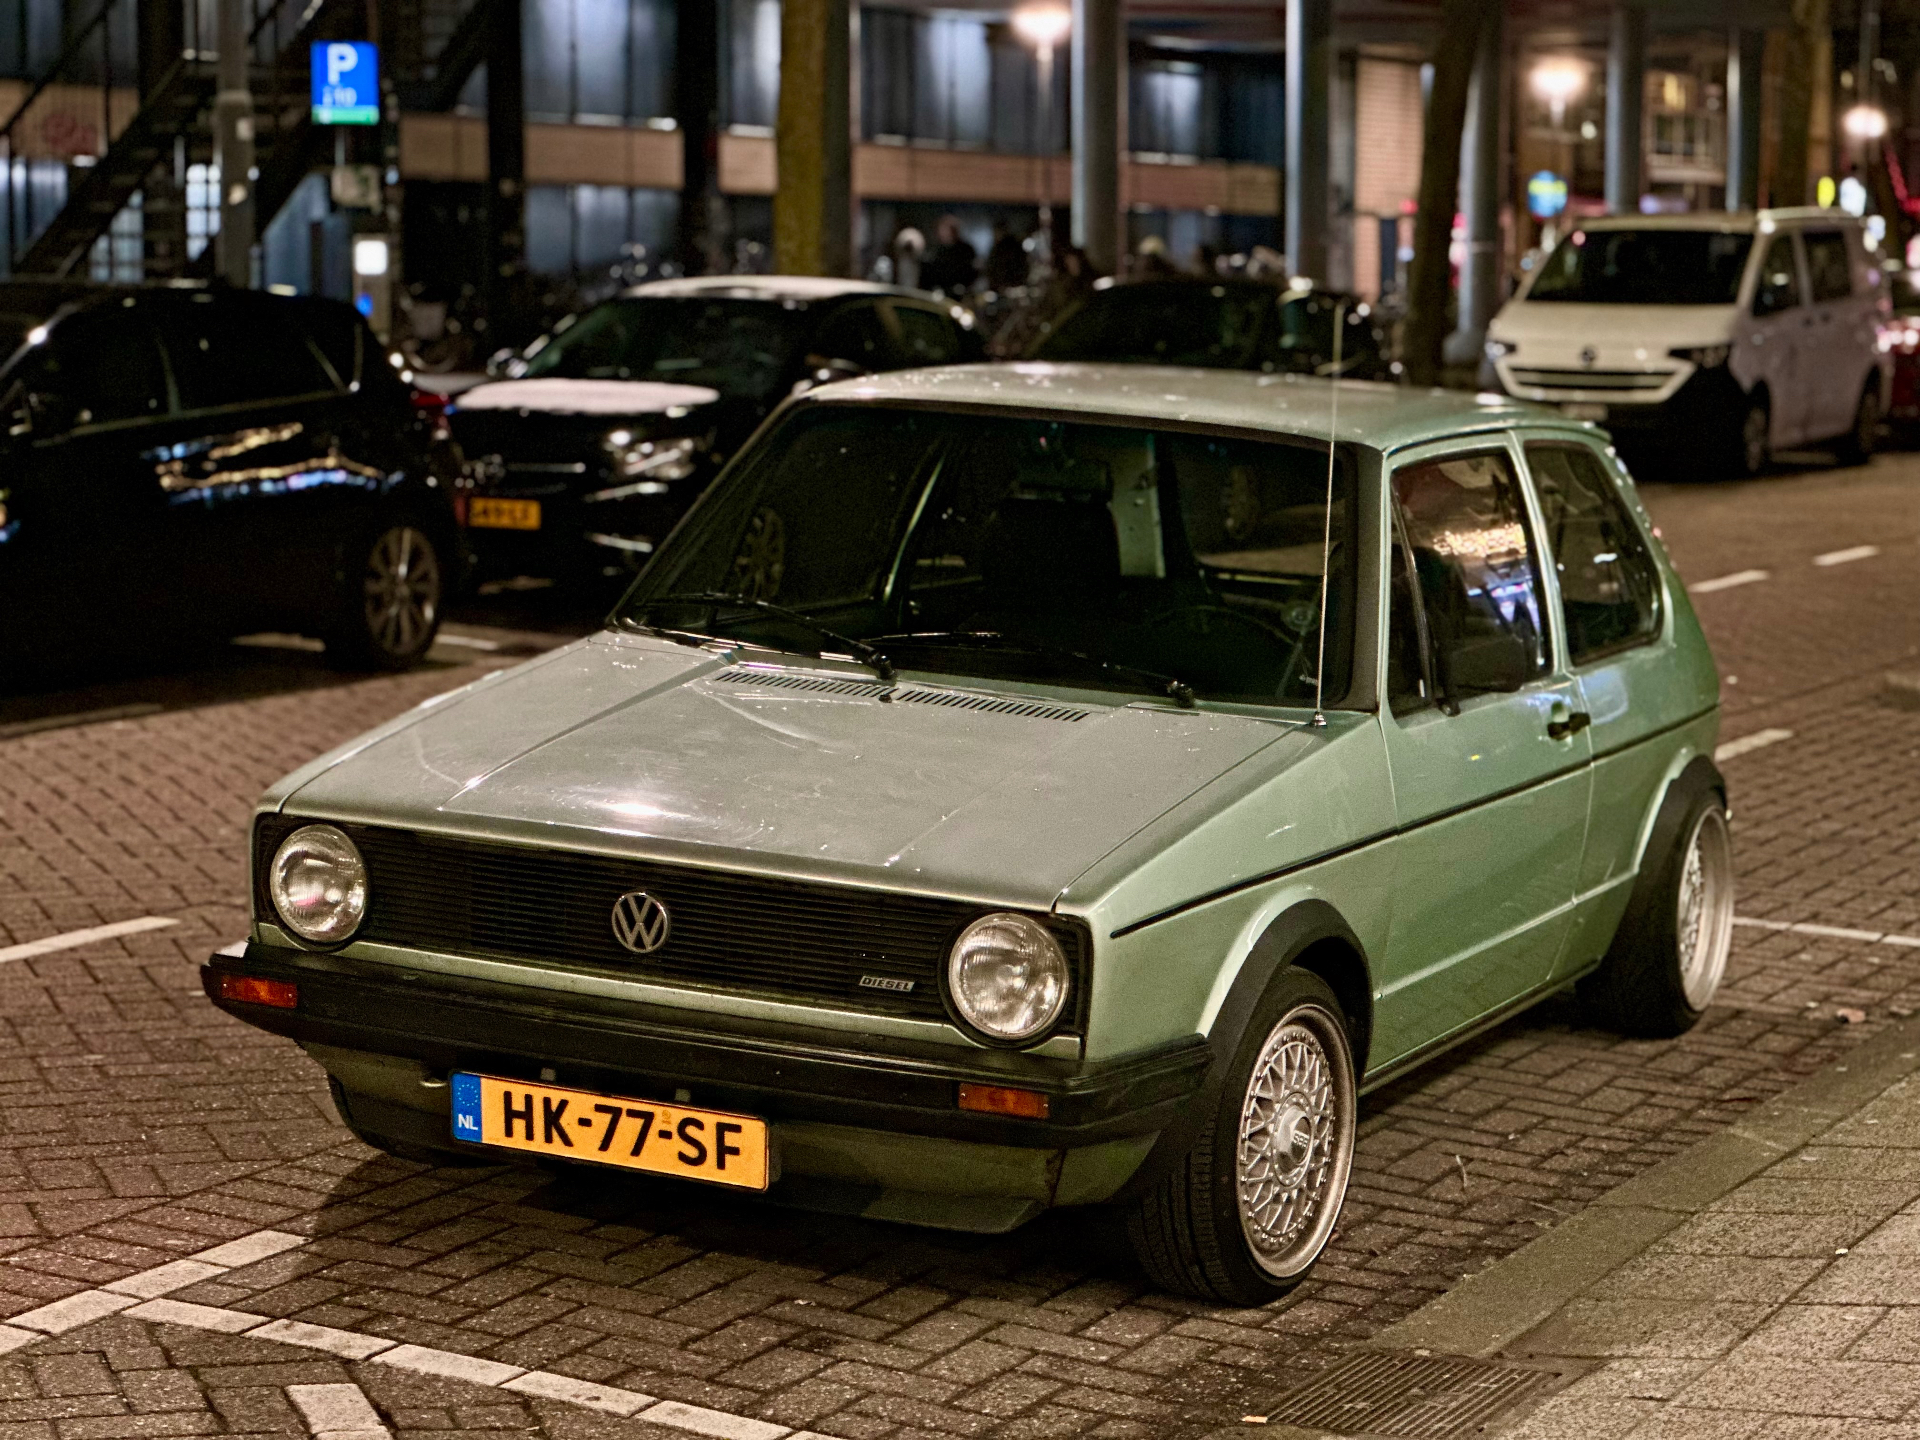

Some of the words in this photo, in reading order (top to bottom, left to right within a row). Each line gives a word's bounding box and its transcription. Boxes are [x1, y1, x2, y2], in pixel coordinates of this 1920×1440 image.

[327, 42, 358, 85] P
[861, 976, 911, 991] DIESEL
[458, 1113, 479, 1131] NL
[503, 1090, 743, 1171] HK-77-SF
